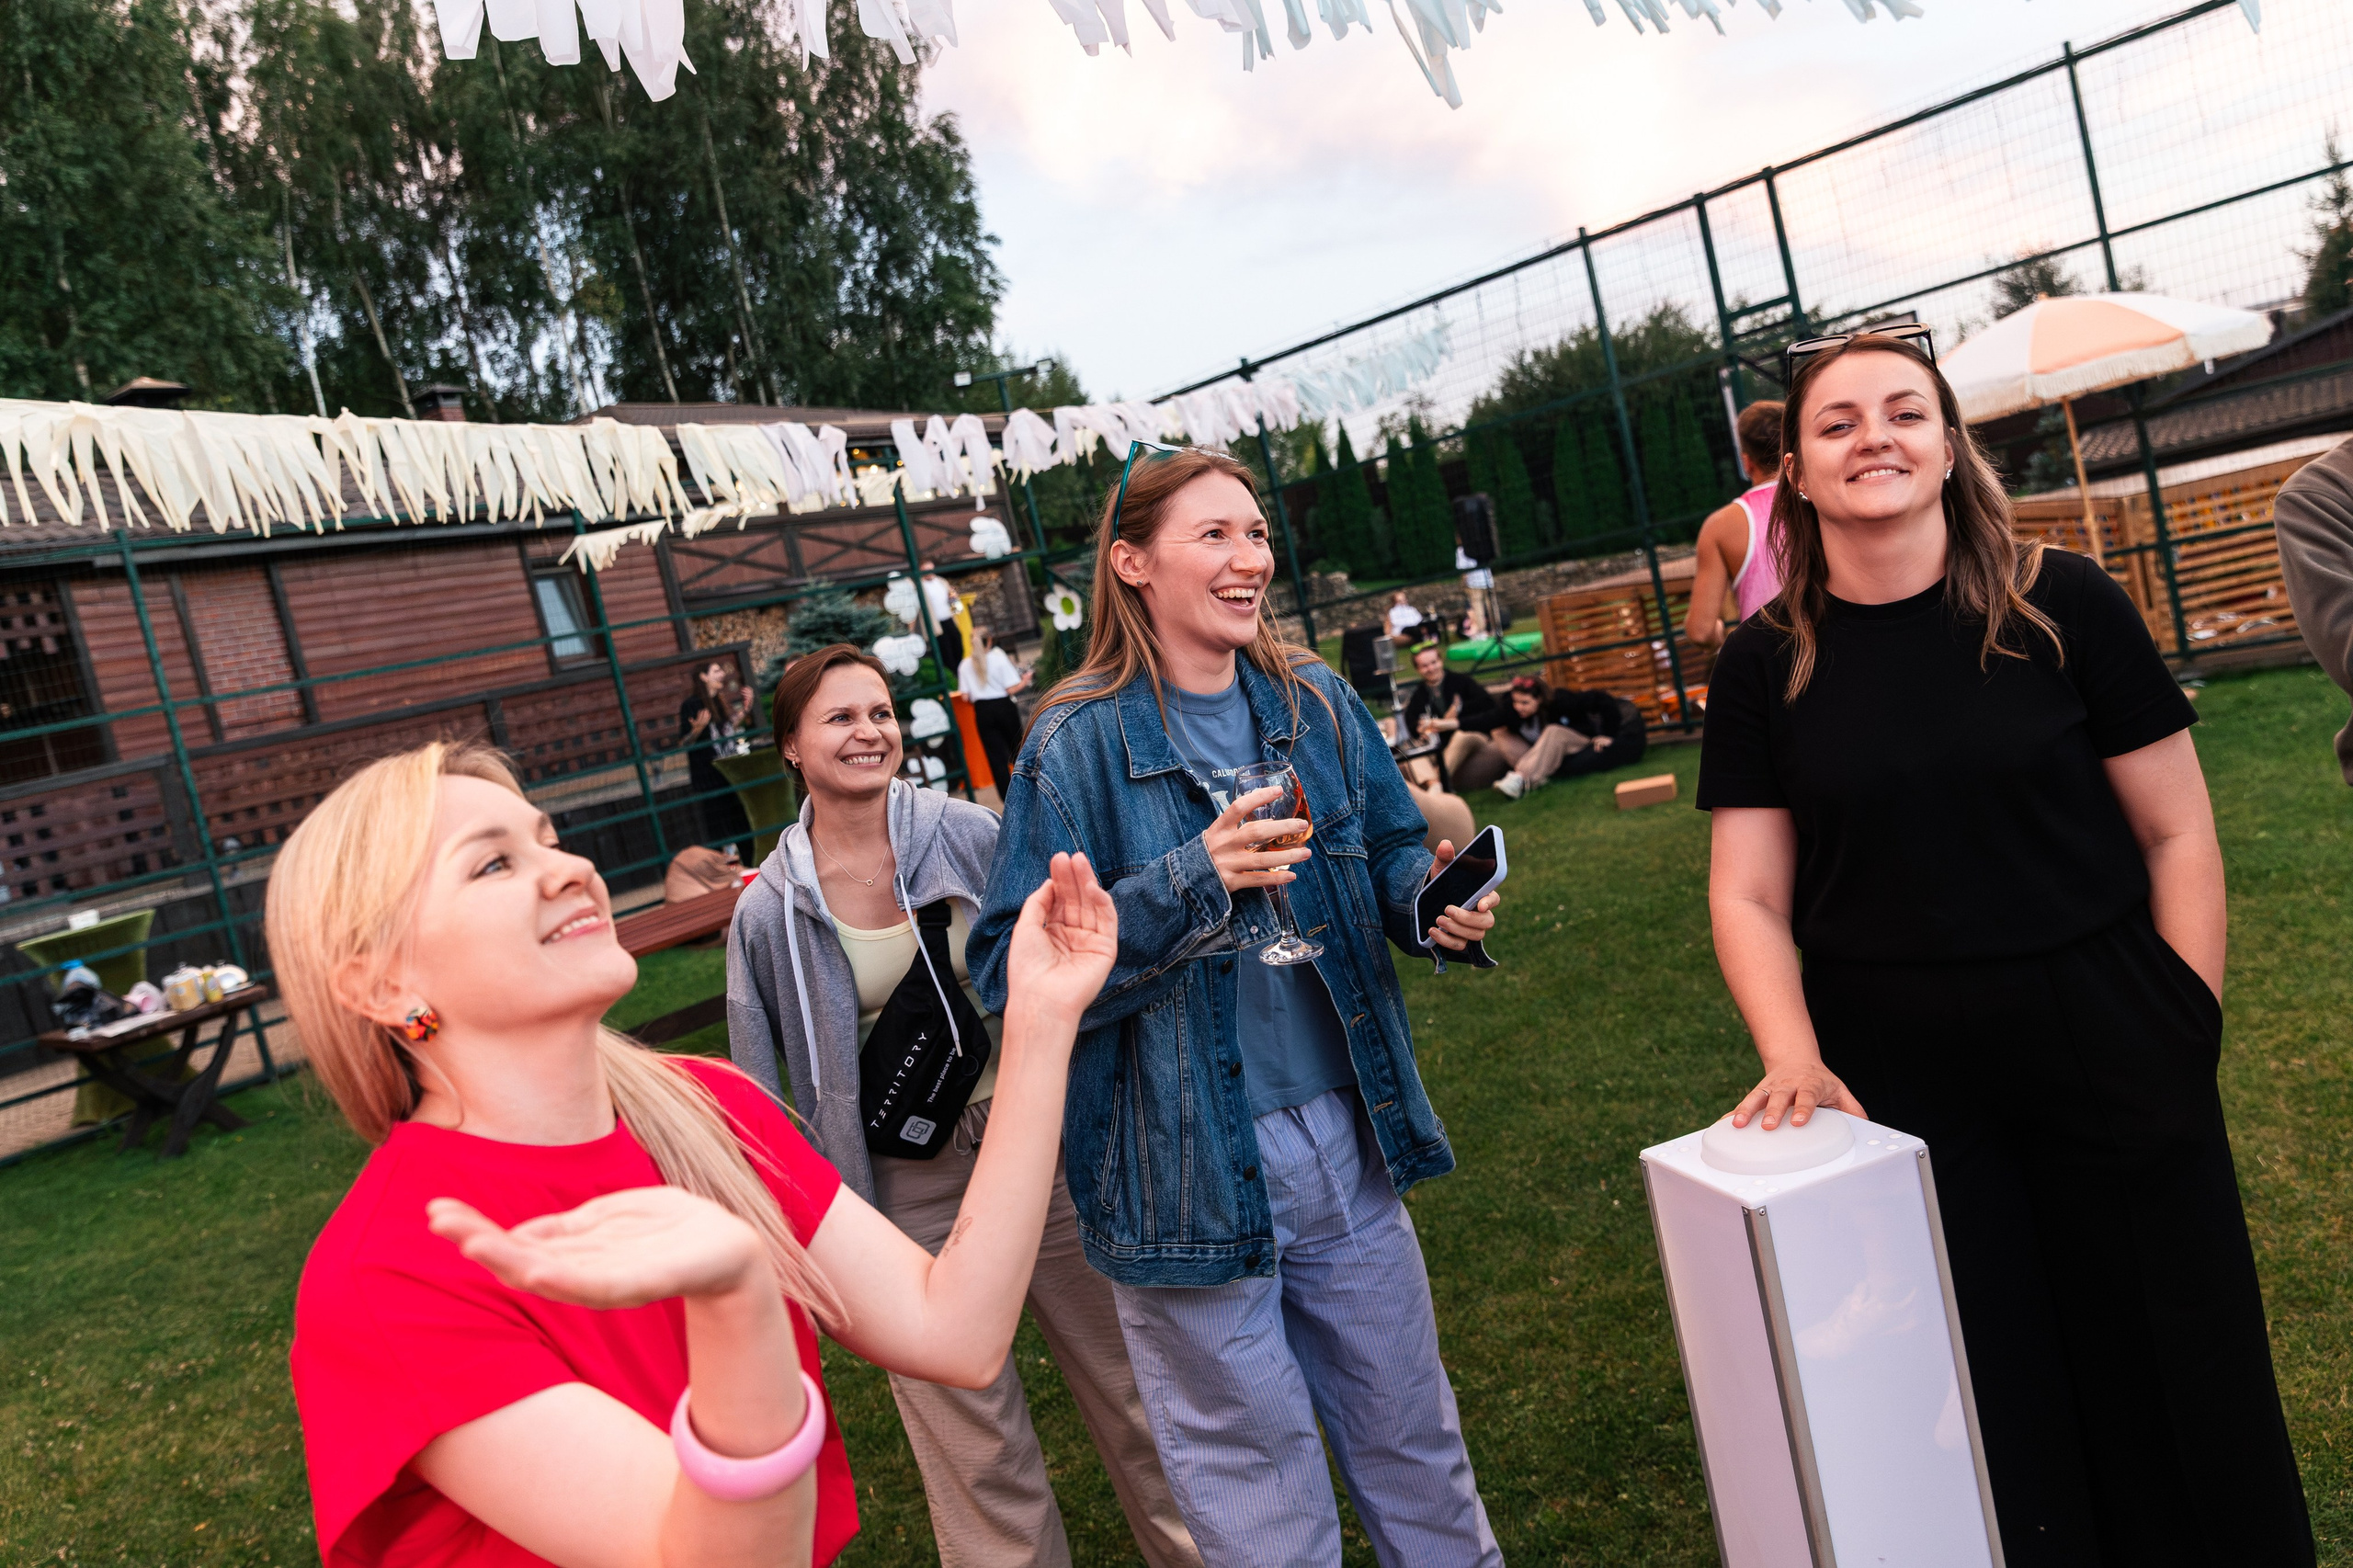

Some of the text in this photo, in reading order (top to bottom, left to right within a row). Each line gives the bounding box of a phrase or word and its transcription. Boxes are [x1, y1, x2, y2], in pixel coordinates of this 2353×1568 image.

[870, 1032, 926, 1128] TERRITORY
[927, 1093, 937, 1103] The
[933, 1079, 943, 1093] best
[939, 1062, 950, 1080] place
[949, 1047, 957, 1056] be
